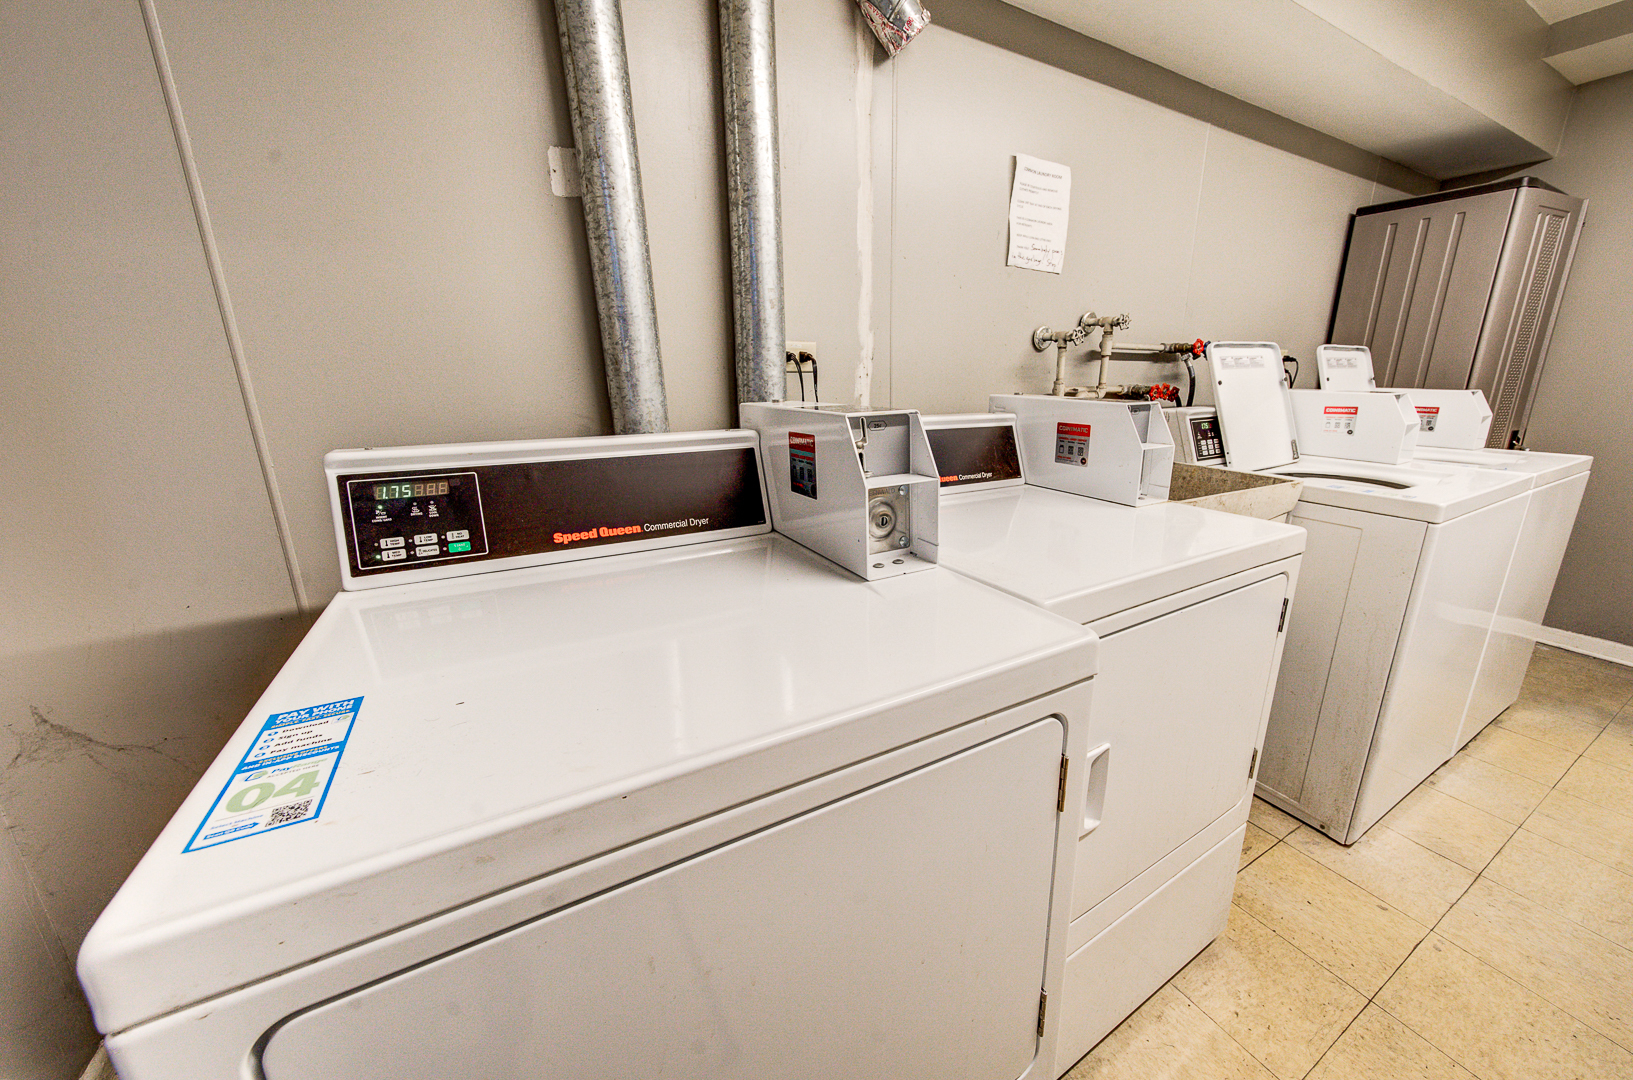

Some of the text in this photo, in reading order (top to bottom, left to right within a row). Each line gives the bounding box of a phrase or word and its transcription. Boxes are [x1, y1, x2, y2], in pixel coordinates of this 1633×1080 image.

[553, 517, 709, 544] Speed Queen Commercial Dryer
[278, 700, 354, 720] PAY WITH
[282, 720, 329, 733] Download
[291, 738, 332, 749] machine
[296, 734, 322, 742] funds
[225, 770, 320, 813] 04
